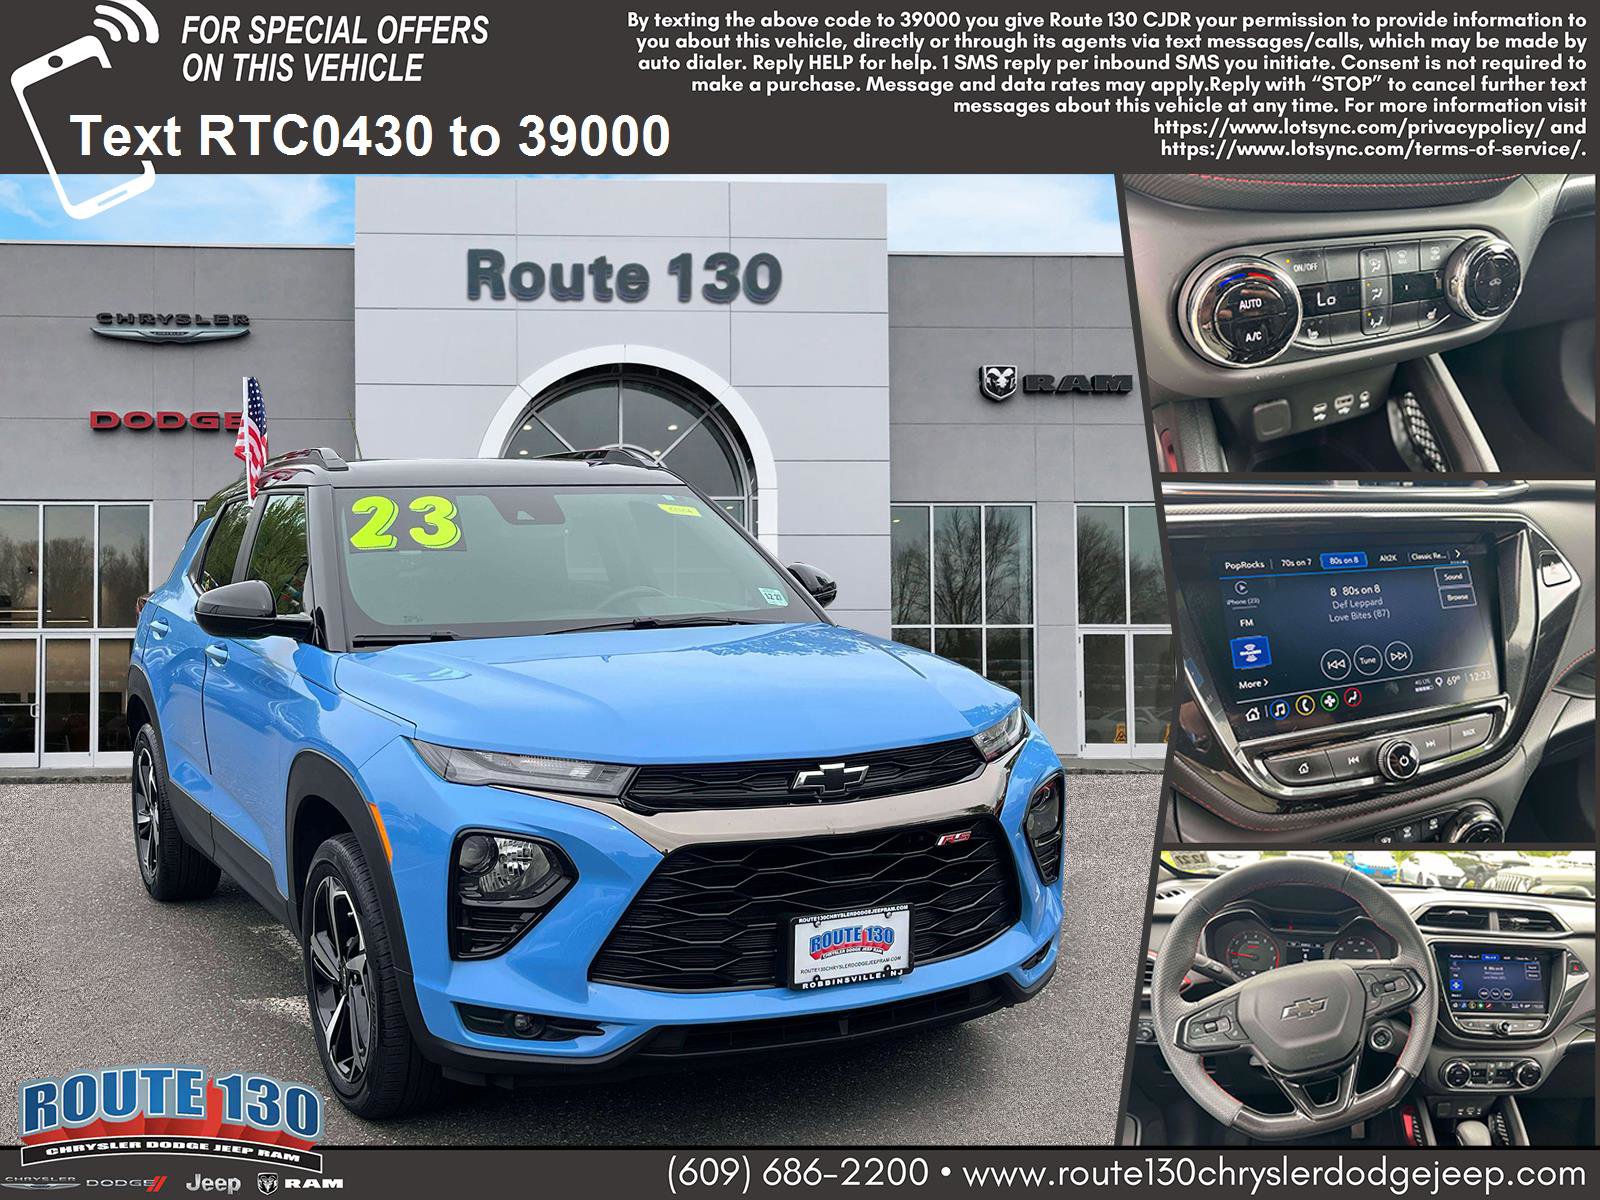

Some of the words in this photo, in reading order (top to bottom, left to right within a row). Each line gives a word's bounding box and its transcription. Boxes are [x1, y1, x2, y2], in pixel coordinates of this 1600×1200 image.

[1293, 263, 1318, 272] ON/OFF
[467, 248, 650, 302] Route
[668, 252, 783, 304] 130
[1240, 299, 1262, 310] AUTO
[96, 312, 250, 326] CHRYSLER
[1246, 332, 1262, 342] A/C
[1022, 375, 1133, 394] RAM
[350, 495, 462, 550] 23
[1225, 561, 1265, 571] PopRocks
[1330, 587, 1337, 597] 8
[1342, 586, 1360, 596] 80s
[1361, 586, 1373, 594] on
[1374, 584, 1381, 593] 8
[1332, 600, 1348, 609] Def
[1349, 597, 1384, 609] Leppard
[1329, 614, 1349, 622] Love
[1351, 611, 1372, 620] Bites
[1373, 609, 1391, 620] (87)
[1240, 619, 1254, 627] FM
[1360, 657, 1377, 665] Tune
[1469, 671, 1492, 682] 12:23
[1238, 681, 1262, 690] More
[809, 926, 863, 955] ROUTE
[865, 925, 895, 944] 130
